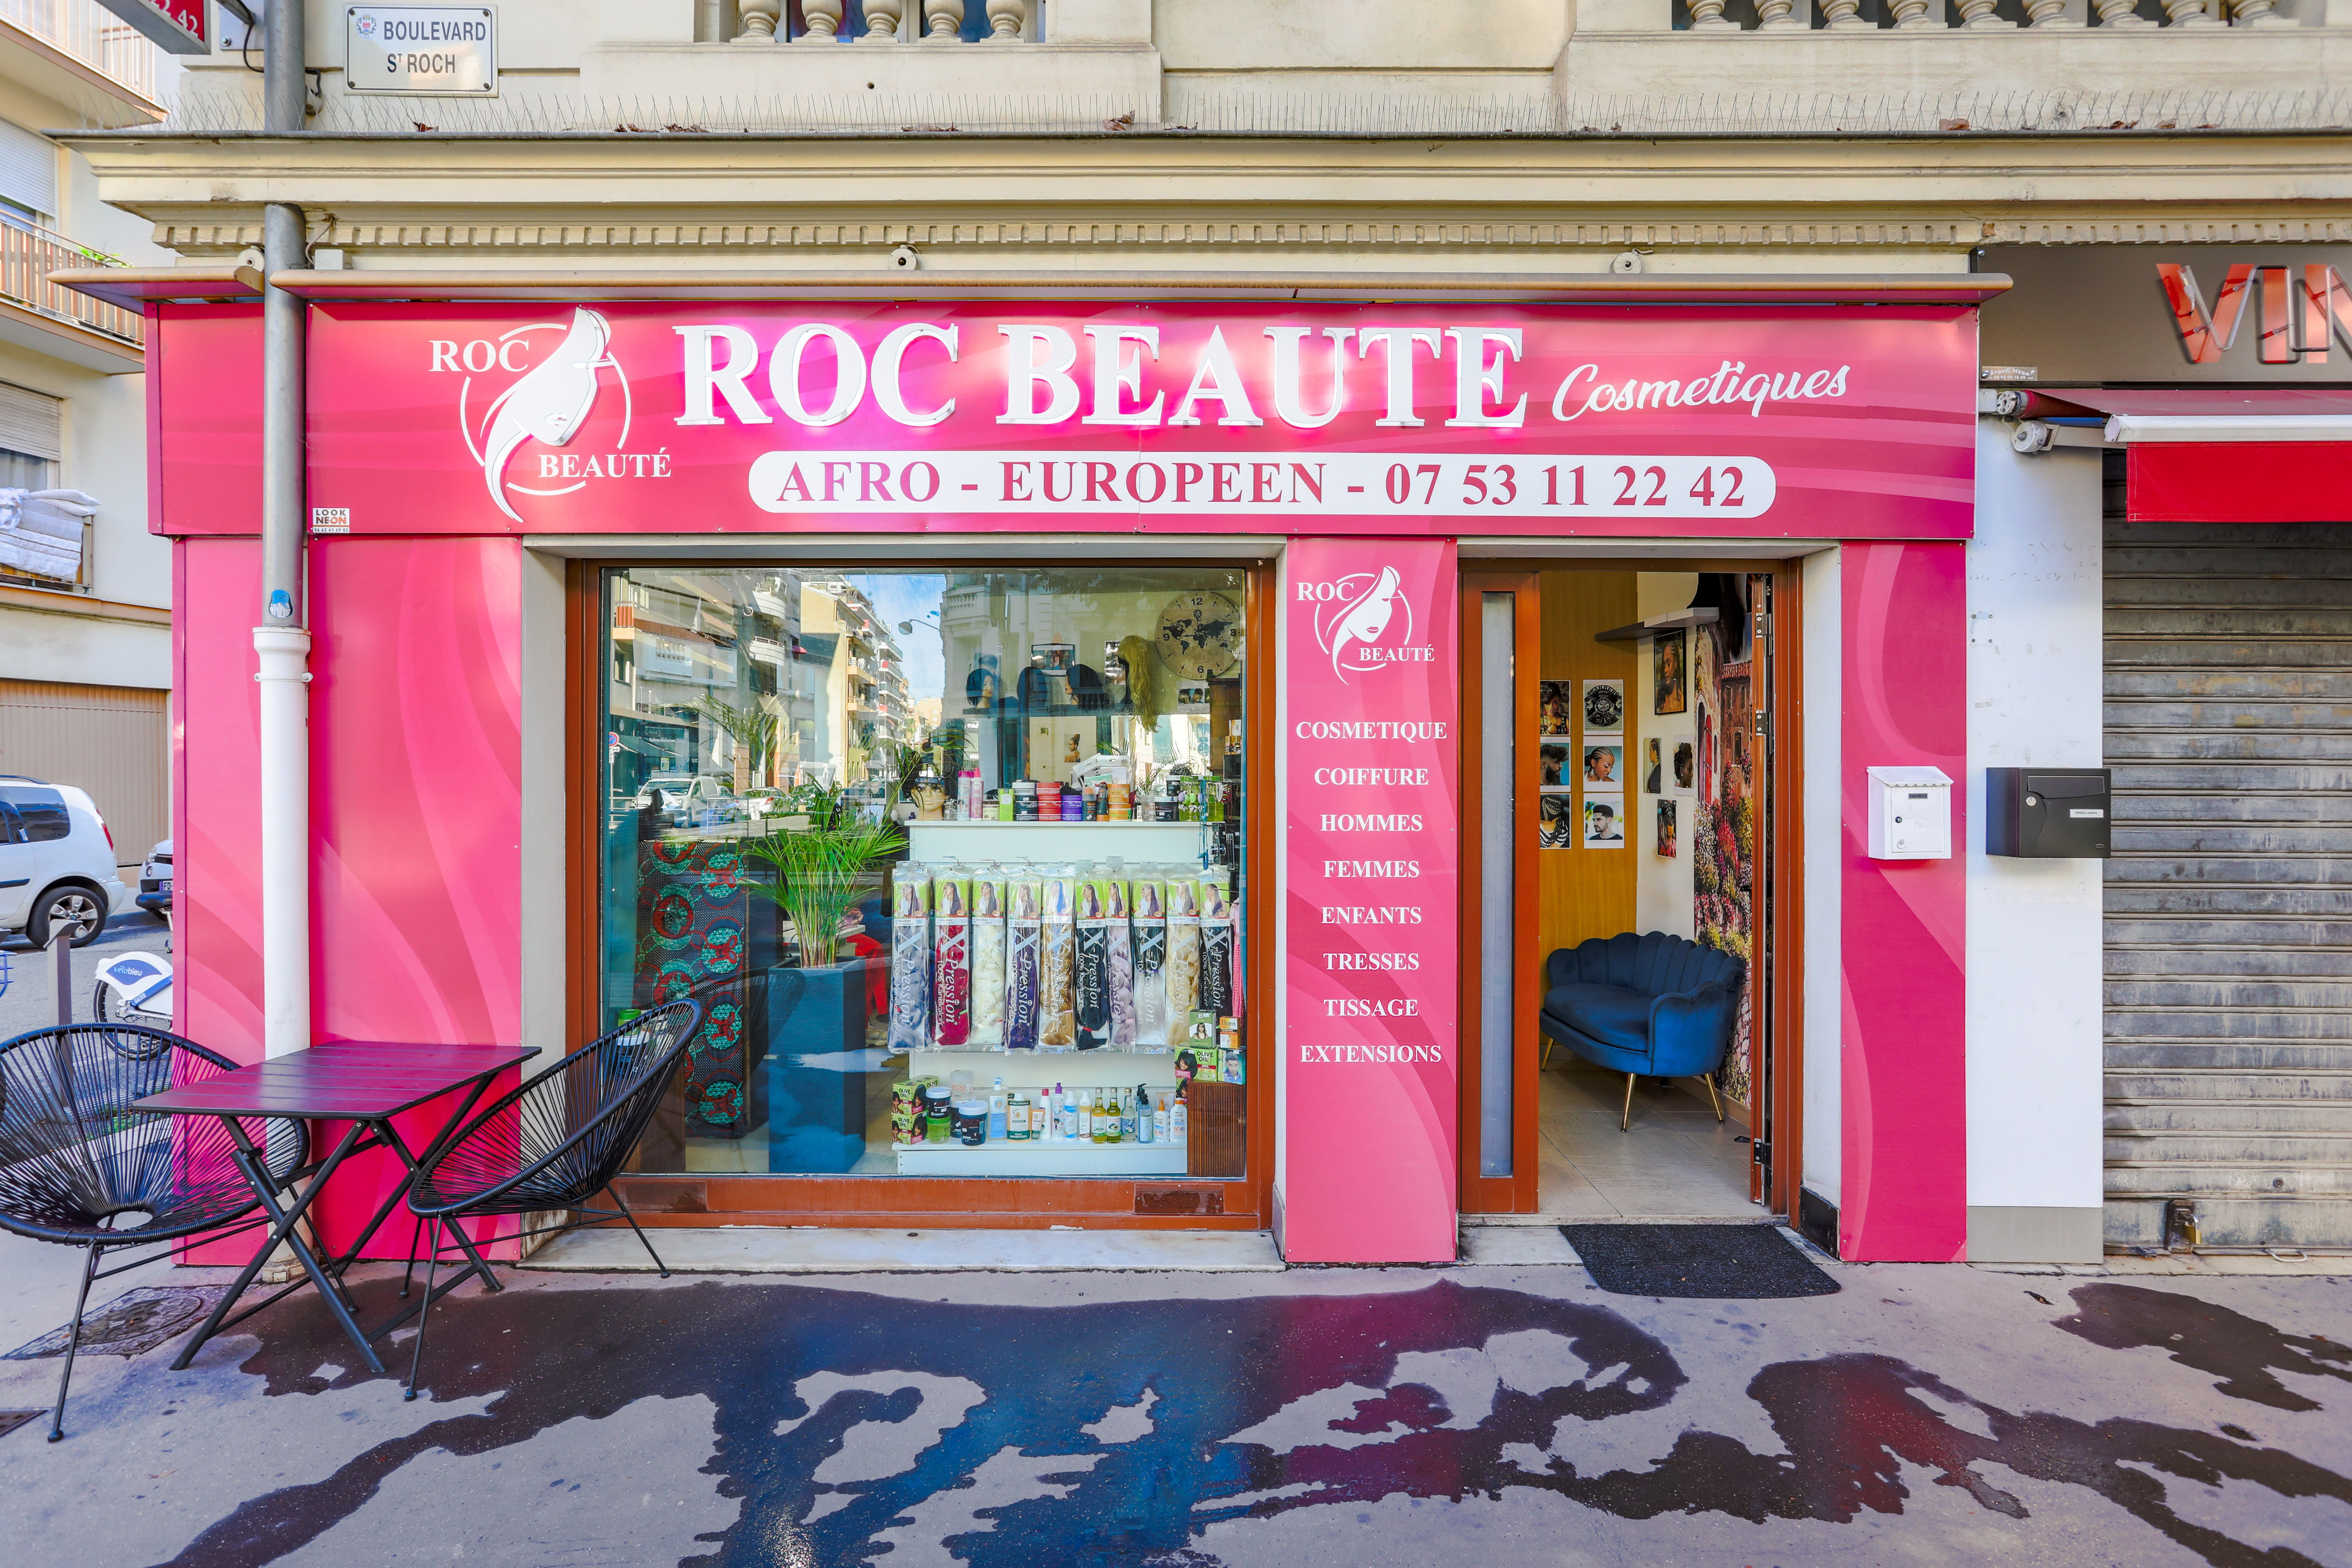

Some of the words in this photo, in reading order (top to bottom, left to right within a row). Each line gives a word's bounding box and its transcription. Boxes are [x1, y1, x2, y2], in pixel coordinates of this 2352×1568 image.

[177, 9, 199, 37] 42
[384, 21, 486, 41] BOULEVARD
[407, 54, 455, 73] ROCH
[428, 340, 530, 372] ROC
[672, 322, 958, 427] ROC
[996, 323, 1528, 429] BEAUTE
[1552, 360, 1851, 421] Cosmetiques
[538, 447, 671, 478] BEAUTÉ
[776, 461, 940, 502] AFRO
[998, 462, 1327, 504] EUROPEEN
[1385, 463, 1442, 505] 07
[1463, 464, 1517, 505] 53
[1542, 465, 1589, 506] 11
[1612, 466, 1668, 506] 22
[1689, 466, 1745, 507] 42
[1296, 582, 1354, 601] ROC
[1191, 597, 1203, 606] 12
[1163, 633, 1170, 641] 9
[1230, 628, 1237, 637] 3
[1359, 644, 1435, 661] BEAUTÉ
[1197, 665, 1204, 674] 6
[1296, 721, 1447, 743] COSMETIQUE
[1314, 767, 1429, 785] COIFFURE
[1320, 814, 1423, 832] HOMMES
[1323, 860, 1420, 878] FEMMES
[1321, 906, 1422, 924] ENFANTS
[114, 965, 142, 976] vélobleu
[1083, 929, 1104, 1008] X-Pression
[1205, 927, 1228, 1007] X-Pression
[1323, 953, 1419, 970] TRESSES
[898, 929, 922, 1023] X-Pression
[940, 929, 965, 1023] X-Pression
[1014, 929, 1037, 1024] X-Pression
[1107, 932, 1127, 1023] X-Pression
[1139, 929, 1164, 1023] X-Pression
[1323, 999, 1419, 1017] TISSAGE
[1300, 1045, 1442, 1063] EXTENSIONS
[926, 1080, 938, 1088] OLIVE
